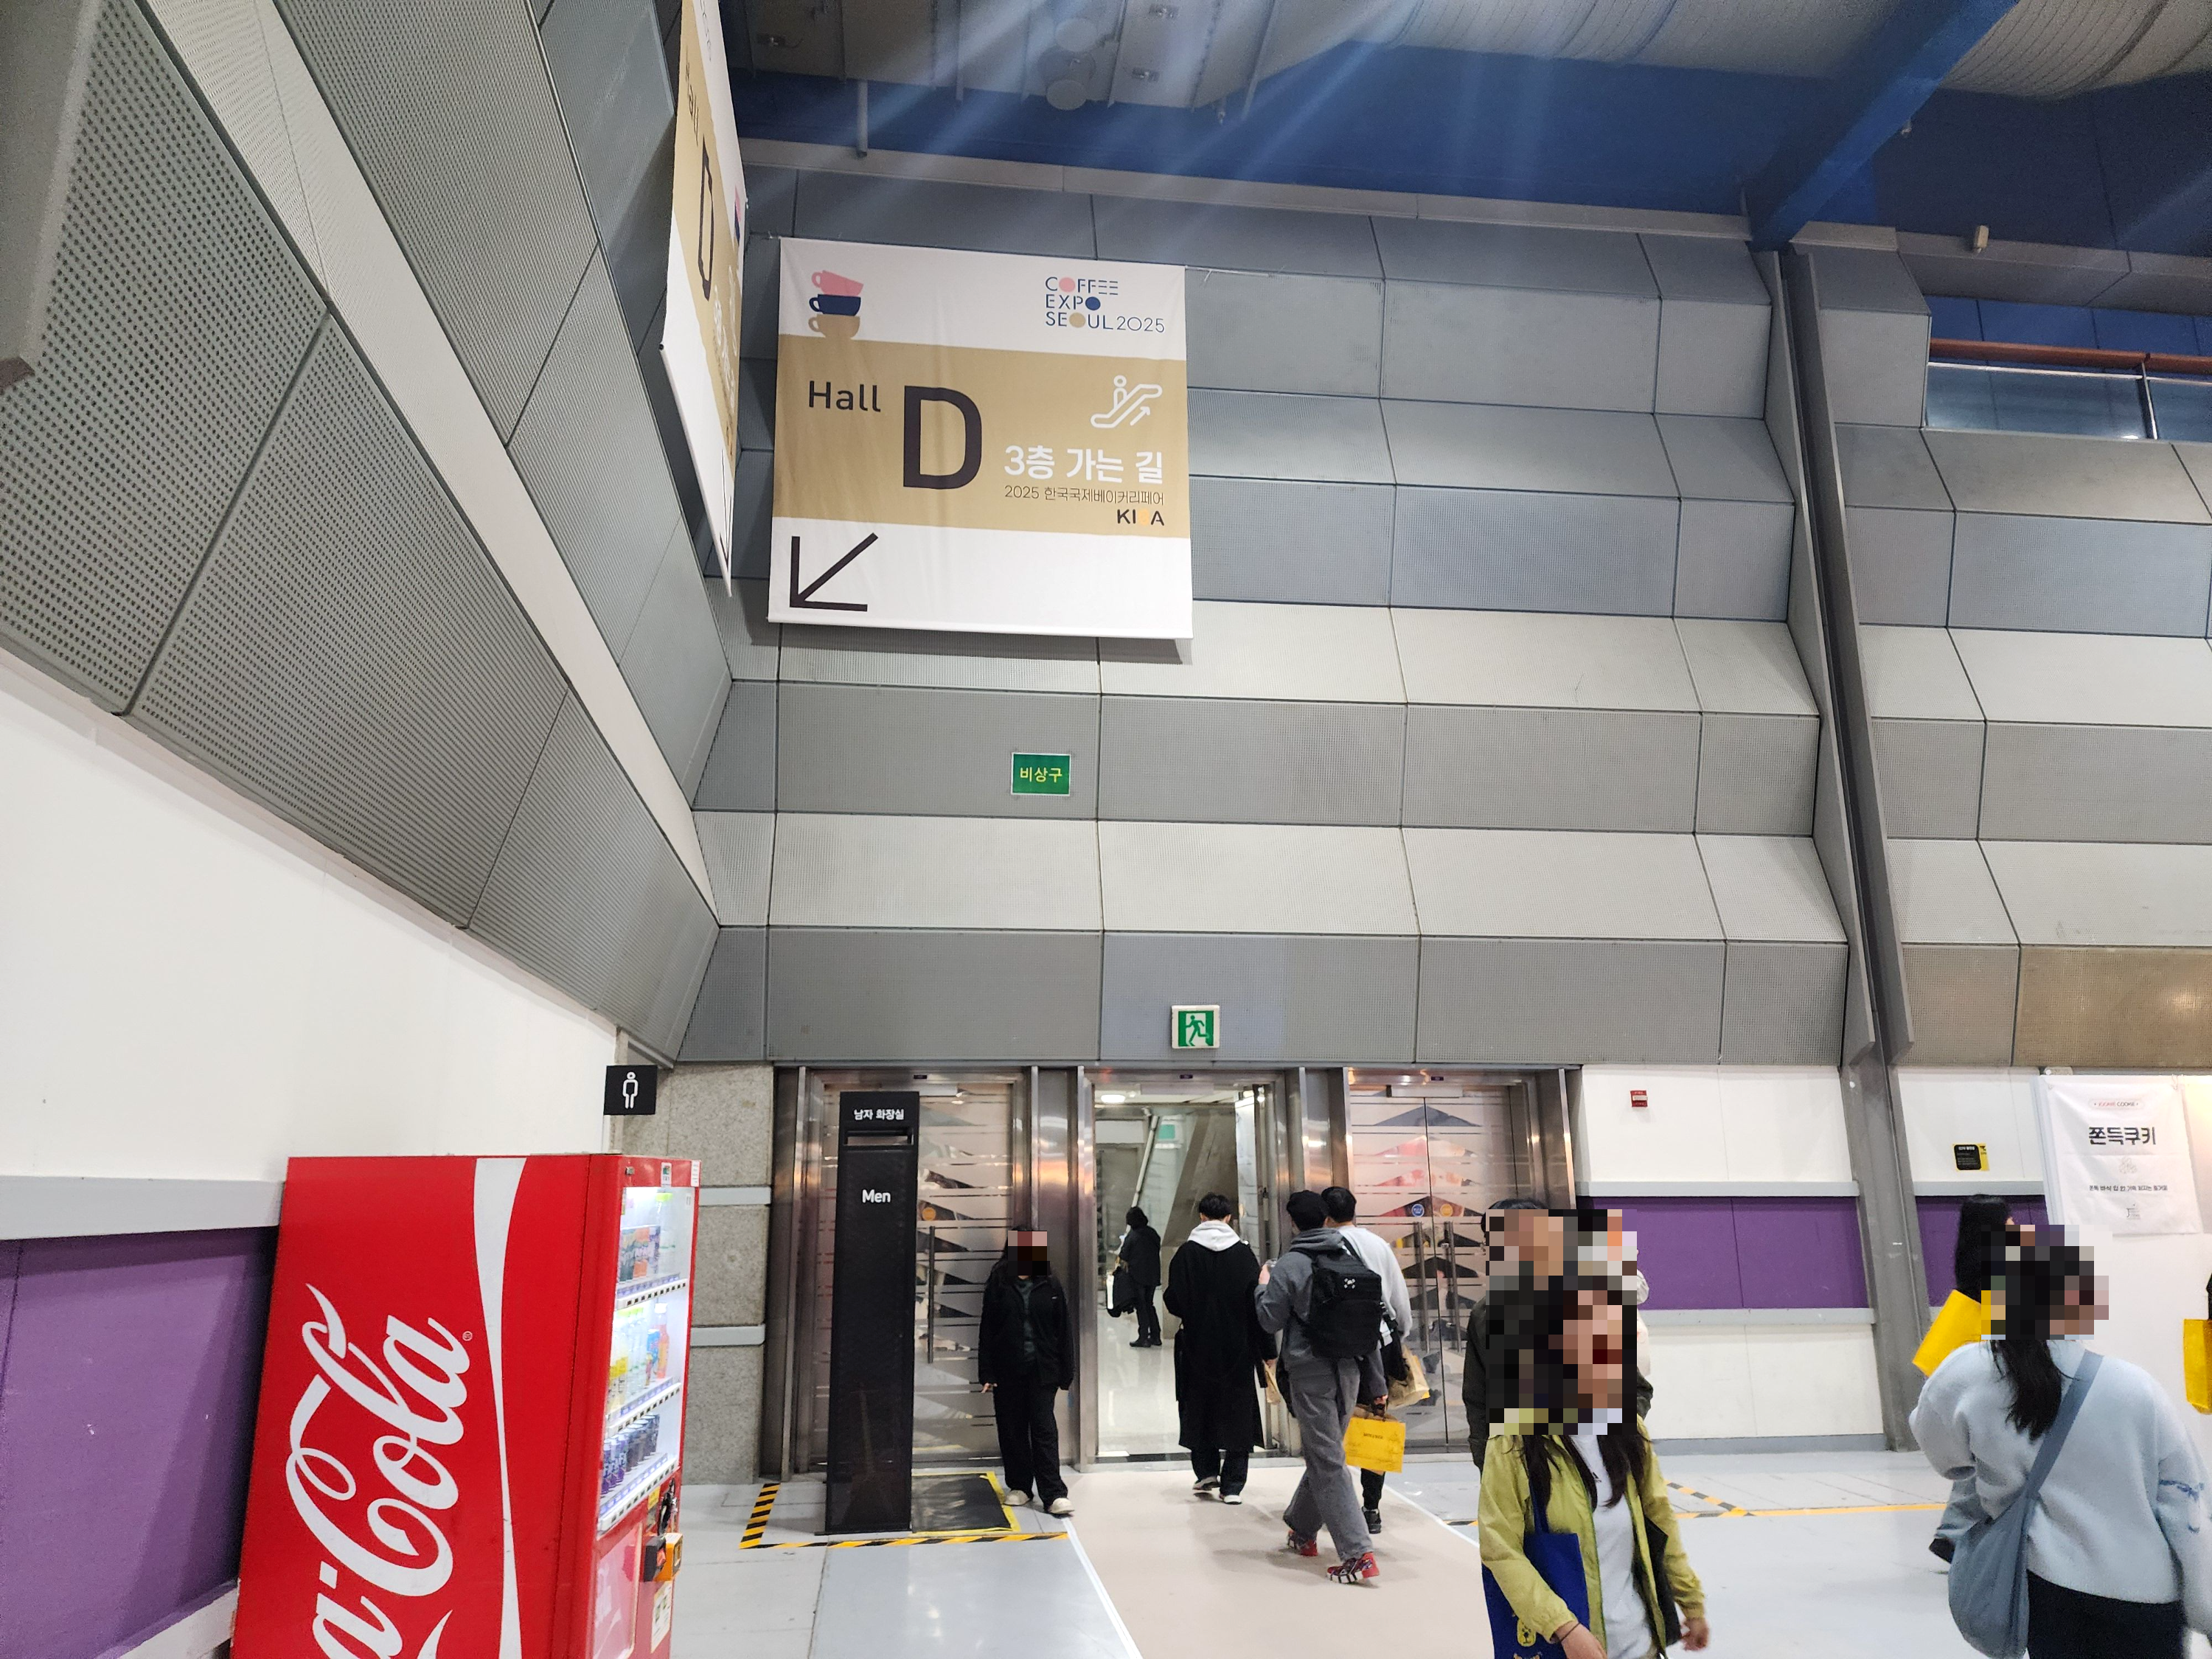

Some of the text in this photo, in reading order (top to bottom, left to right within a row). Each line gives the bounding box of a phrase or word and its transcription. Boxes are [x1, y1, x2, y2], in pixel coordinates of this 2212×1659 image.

[697, 133, 714, 302] D
[1045, 276, 1119, 296] COFFEE
[1046, 293, 1101, 311] EXPO
[1045, 311, 1165, 333] SEOUL 2025
[809, 380, 881, 413] Hall
[903, 384, 983, 490] D
[1004, 445, 1163, 485] 3층 가는 길
[1004, 485, 1164, 507] 2025 한국국제베이커리페어
[1019, 766, 1063, 783] 비상구
[853, 1108, 905, 1121] 남자 화장실
[2088, 1126, 2157, 1145] 쫀득쿠키
[861, 1189, 891, 1203] Men
